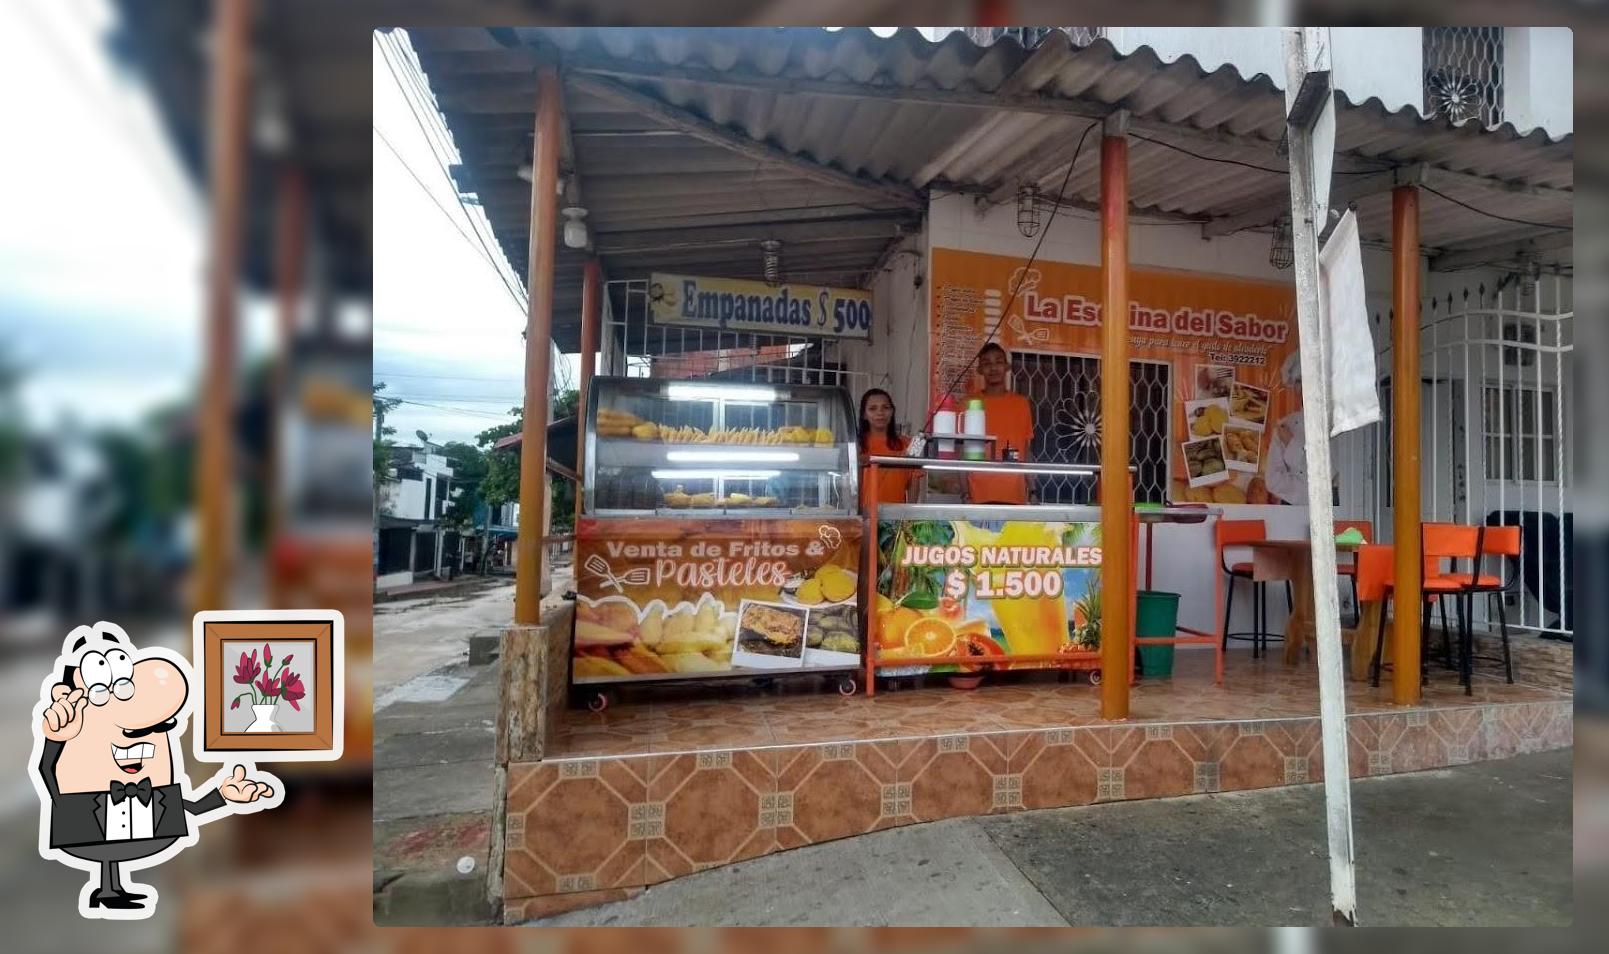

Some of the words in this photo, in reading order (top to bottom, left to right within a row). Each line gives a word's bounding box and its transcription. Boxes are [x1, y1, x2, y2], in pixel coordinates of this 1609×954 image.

[681, 279, 811, 329] Empanadas
[833, 297, 871, 333] 500
[1026, 293, 1059, 320] La
[1065, 297, 1168, 330] Esina
[1173, 310, 1212, 334] del
[1217, 313, 1287, 341] Sabor
[607, 541, 683, 558] Venta
[690, 541, 722, 557] de
[730, 540, 800, 557] Fritos
[805, 540, 825, 556] &
[901, 545, 976, 566] JUGOS
[981, 545, 1103, 567] NATURALES
[655, 557, 791, 588] Pasteles
[947, 569, 966, 598] $
[976, 571, 1062, 598] 1.500
